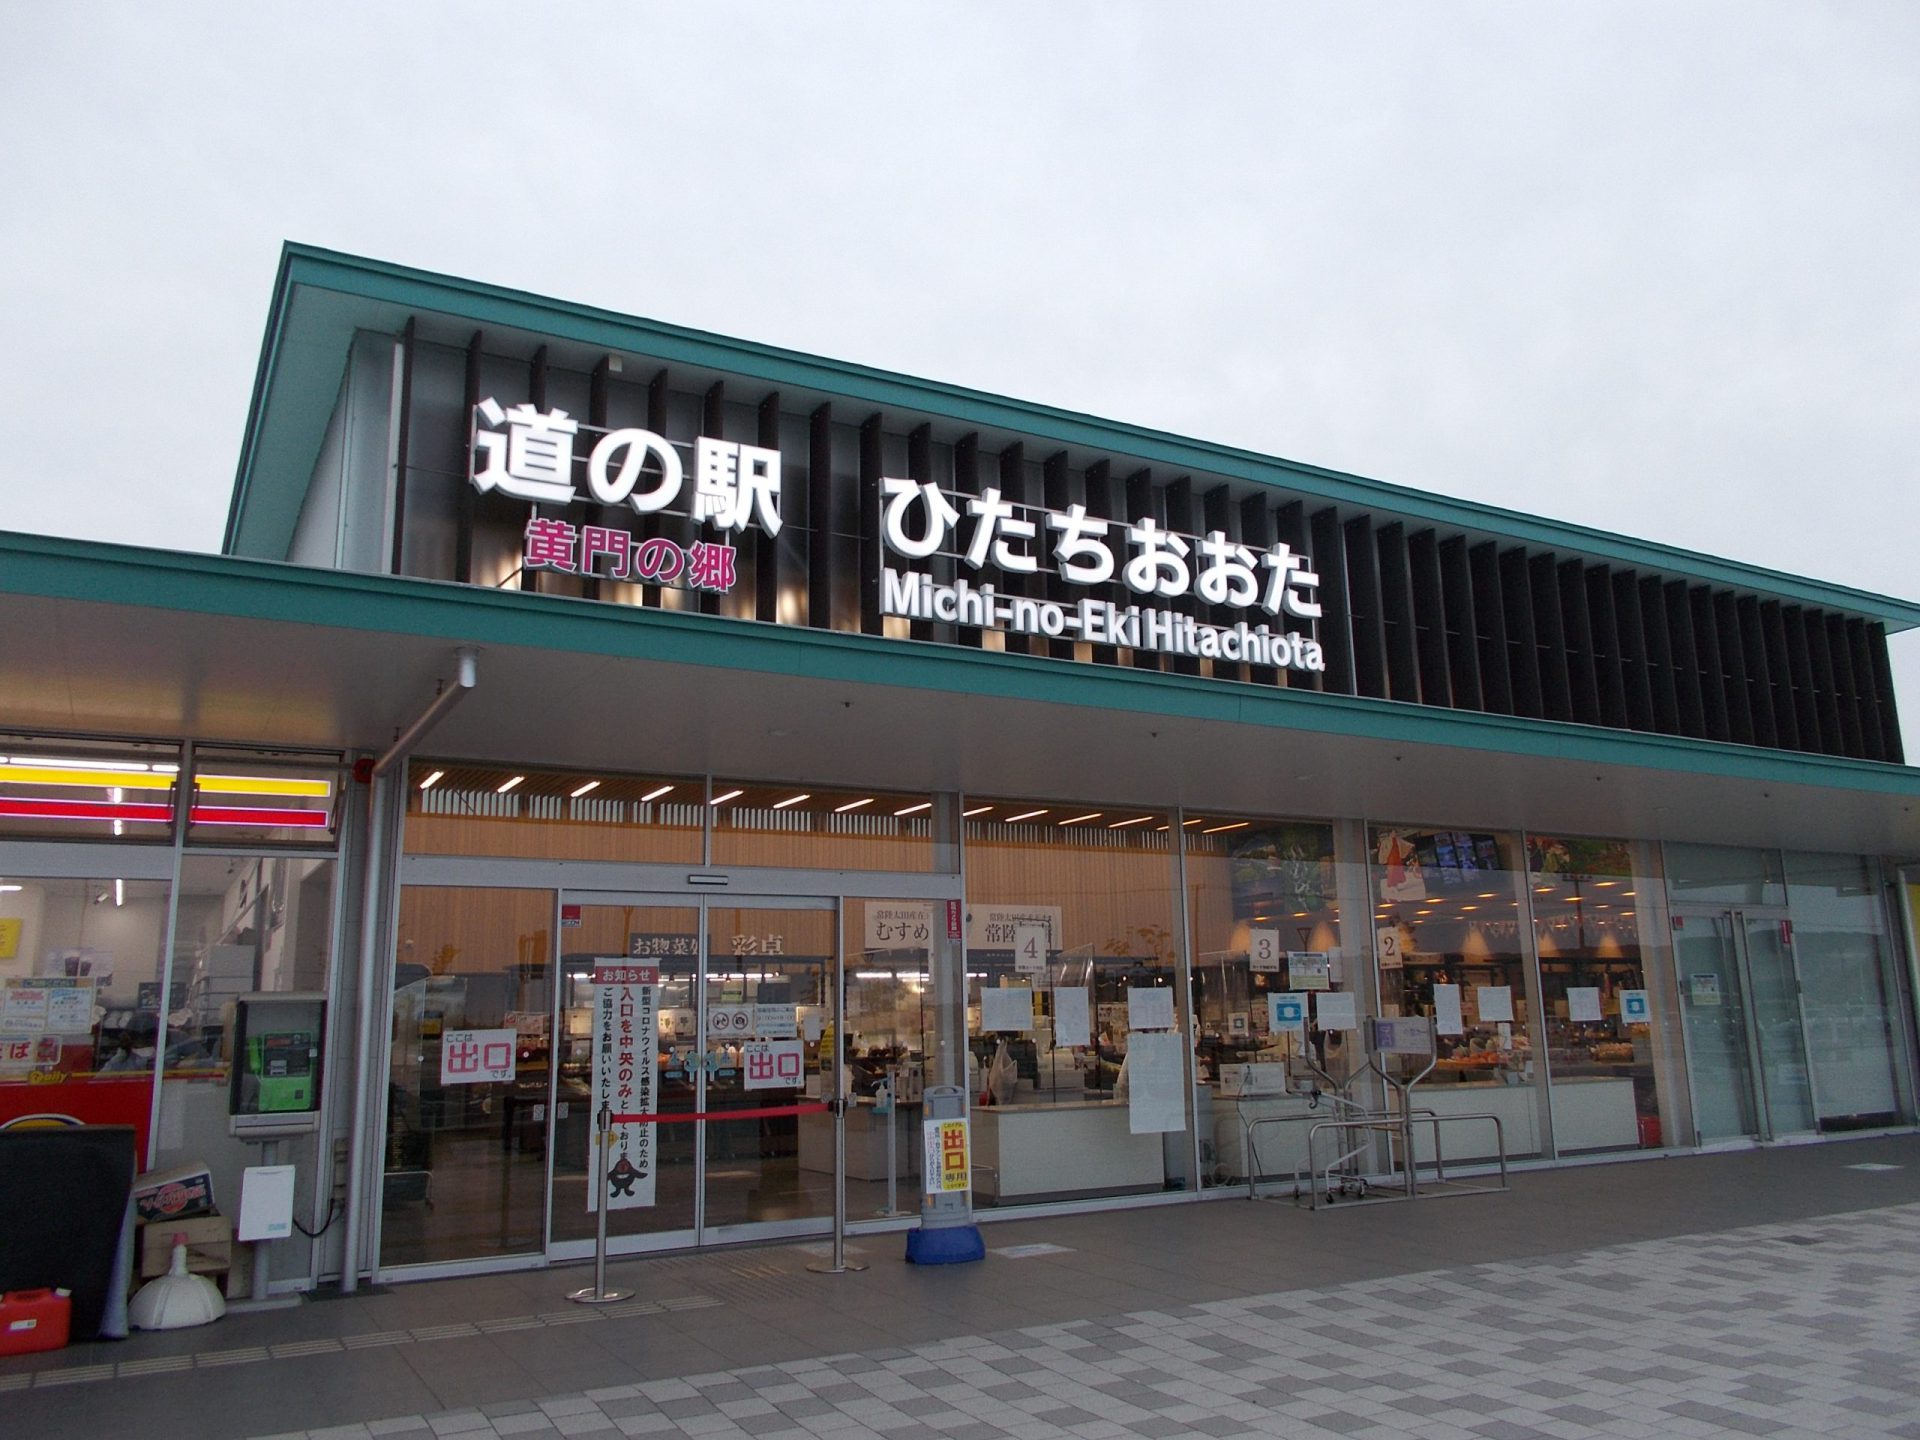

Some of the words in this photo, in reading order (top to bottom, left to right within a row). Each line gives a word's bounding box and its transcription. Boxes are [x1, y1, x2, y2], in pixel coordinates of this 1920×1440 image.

[470, 397, 783, 539] 道の駅
[524, 518, 737, 594] 黄門の郷
[883, 477, 1322, 619] ひたちおおた
[880, 568, 1142, 647] Michi-no-Eki
[1142, 607, 1326, 673] Hitachiota
[876, 922, 929, 941] むすめ
[1023, 936, 1038, 959] 4
[1258, 938, 1271, 959] 3
[1383, 936, 1395, 956] 2
[603, 969, 651, 981] お知らせ
[446, 1032, 474, 1042] ここは
[448, 1042, 512, 1073] 出口
[749, 1052, 800, 1079] 出口
[944, 1129, 964, 1170] 出口
